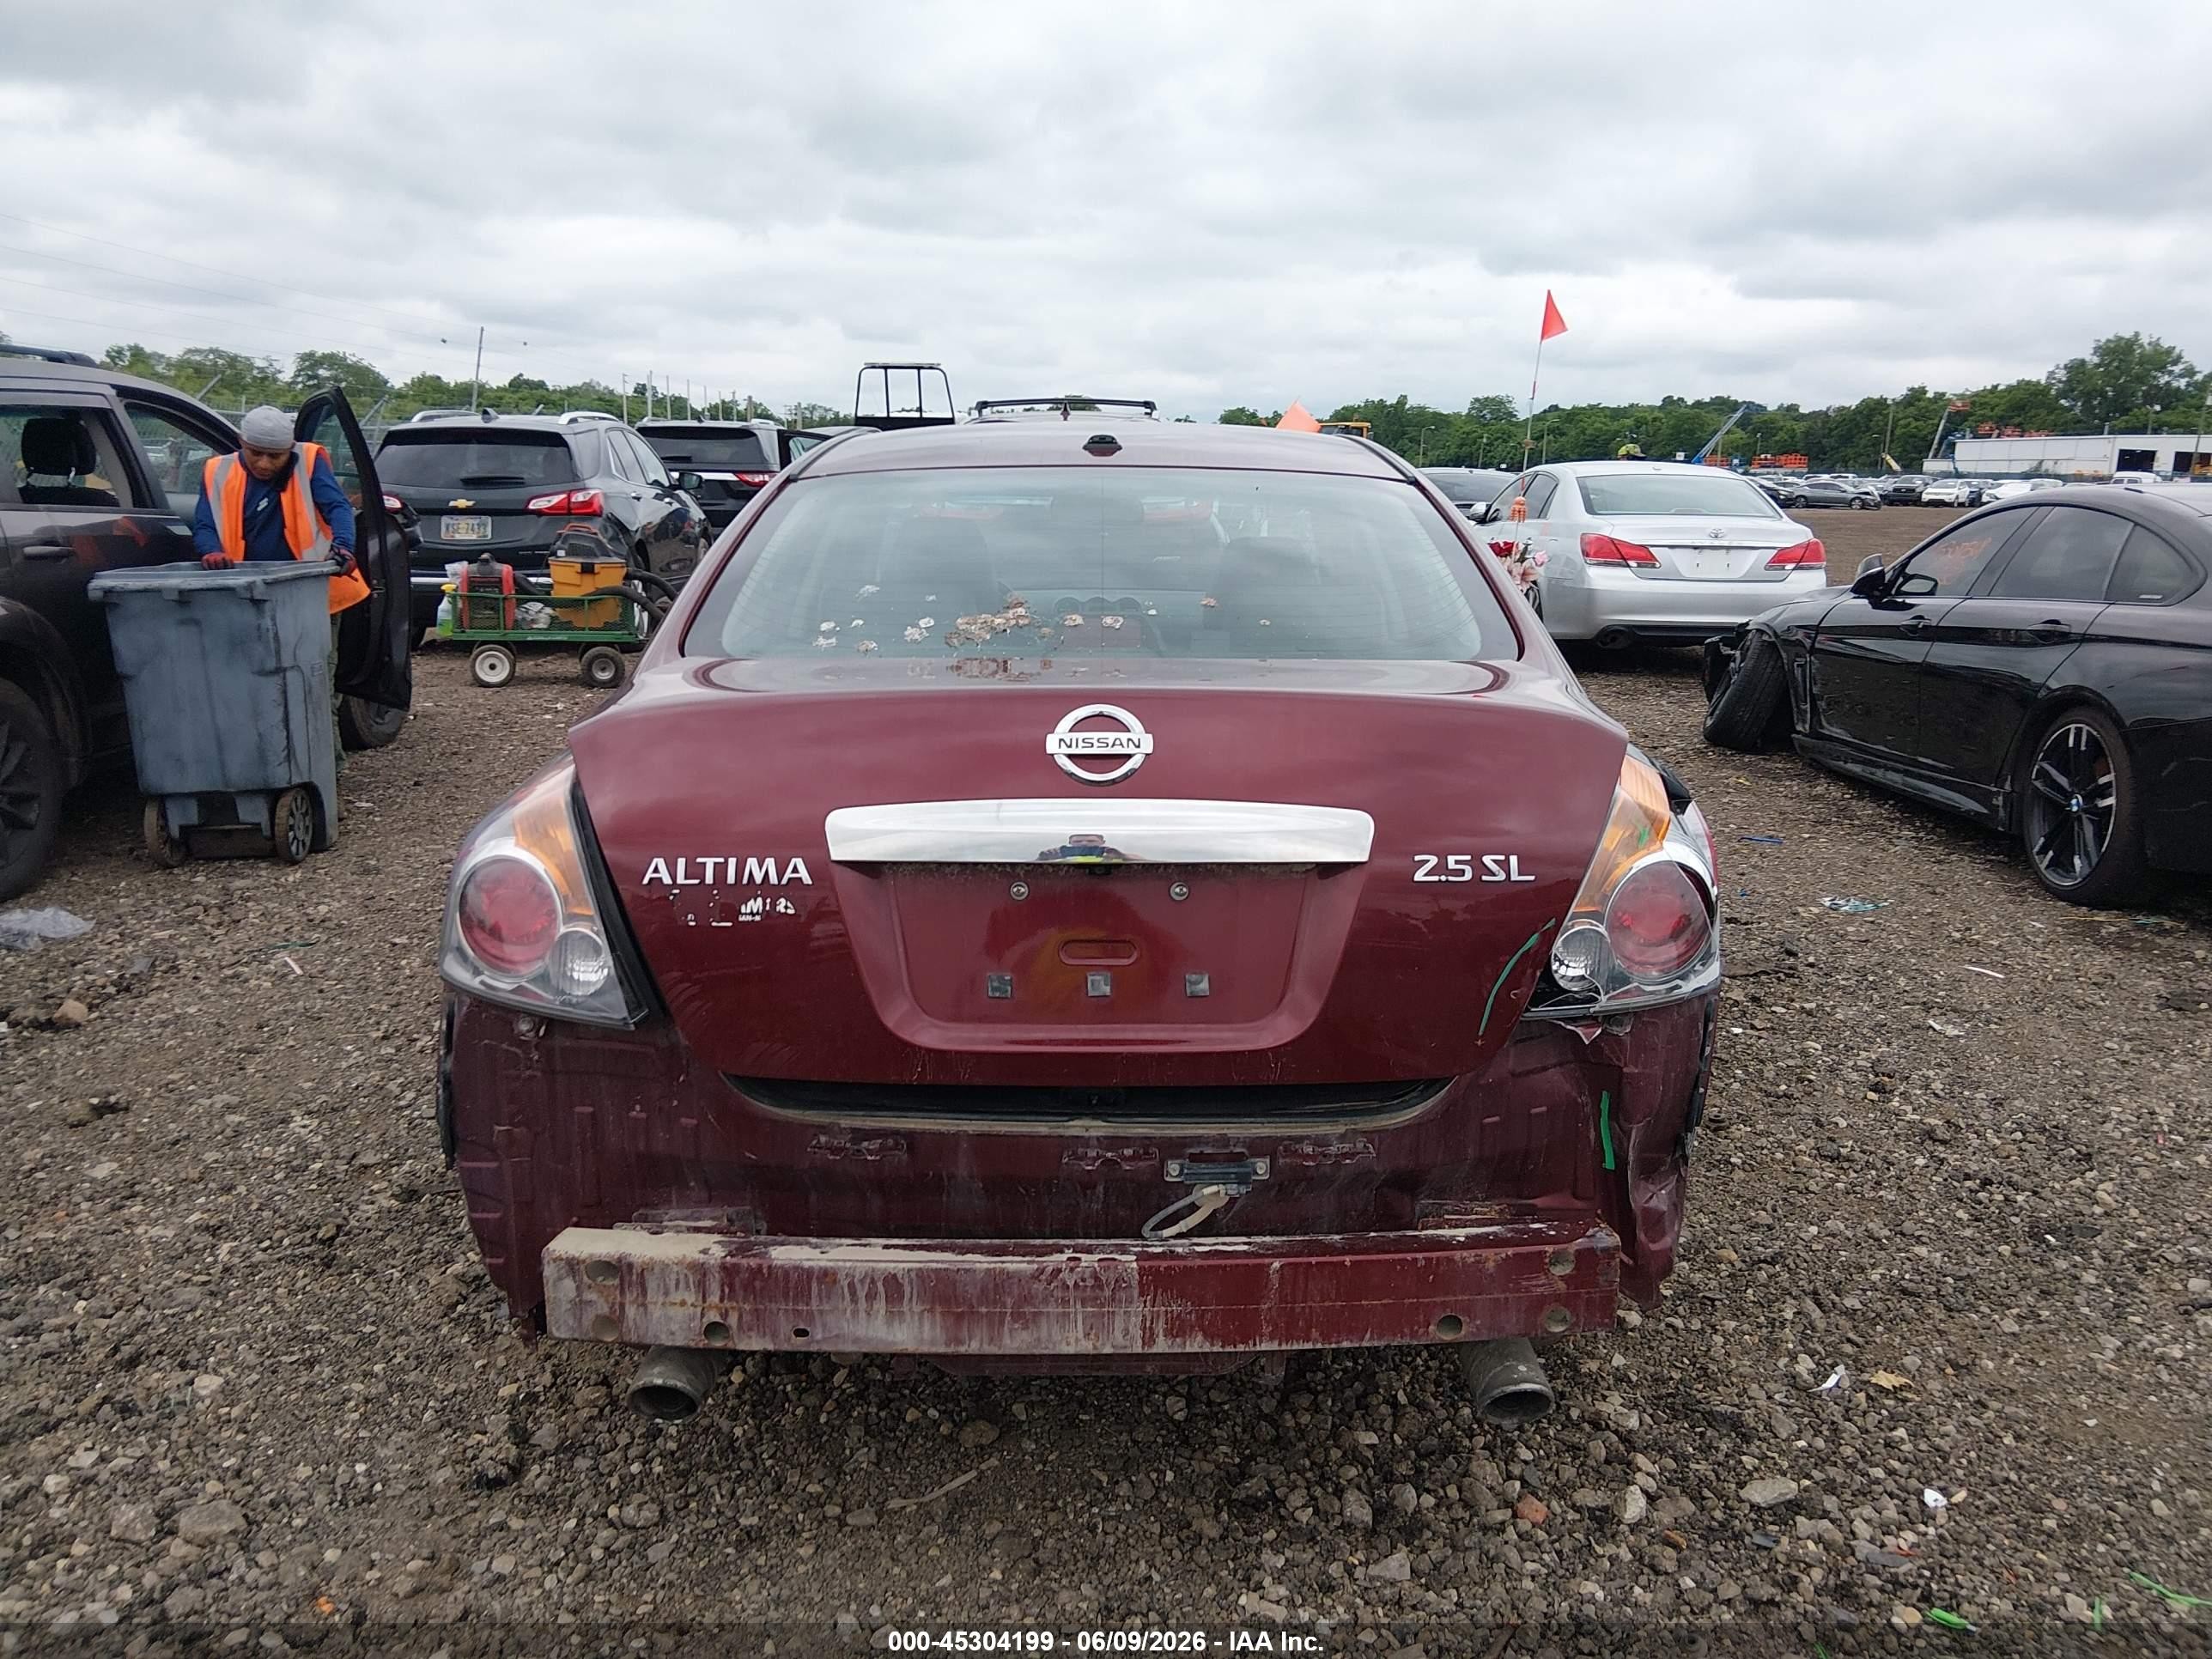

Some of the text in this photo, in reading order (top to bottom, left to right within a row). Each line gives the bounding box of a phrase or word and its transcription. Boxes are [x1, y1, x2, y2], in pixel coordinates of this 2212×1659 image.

[1058, 737, 1141, 750] NISSAN
[641, 857, 813, 885] ALTIMA
[1413, 854, 1536, 882] 2.5 SL
